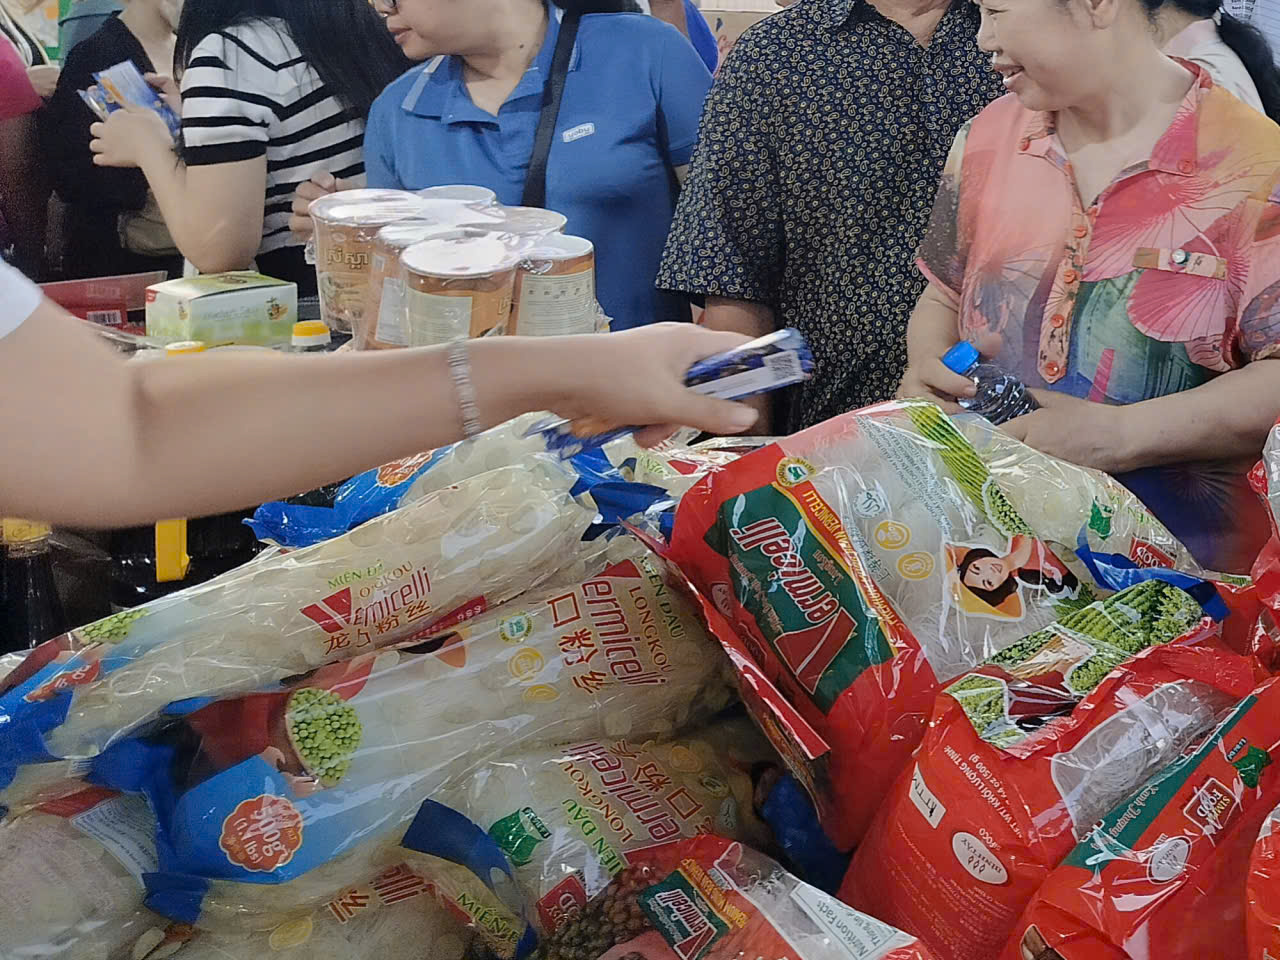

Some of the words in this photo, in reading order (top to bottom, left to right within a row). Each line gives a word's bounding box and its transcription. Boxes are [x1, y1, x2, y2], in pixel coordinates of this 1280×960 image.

[802, 490, 841, 537] VERMICELLI
[359, 561, 414, 599] OGKOU
[729, 517, 858, 695] Vermicelli
[628, 586, 676, 673] LONGKOU
[957, 759, 986, 791] LƯỢNG
[973, 759, 994, 781] (500
[988, 775, 1001, 789] oz
[557, 760, 635, 844] LONGKOU
[560, 742, 682, 842] ermicelli
[244, 841, 264, 864] lbs)
[655, 888, 717, 960] Vermicelli
[815, 899, 839, 926] Facts
